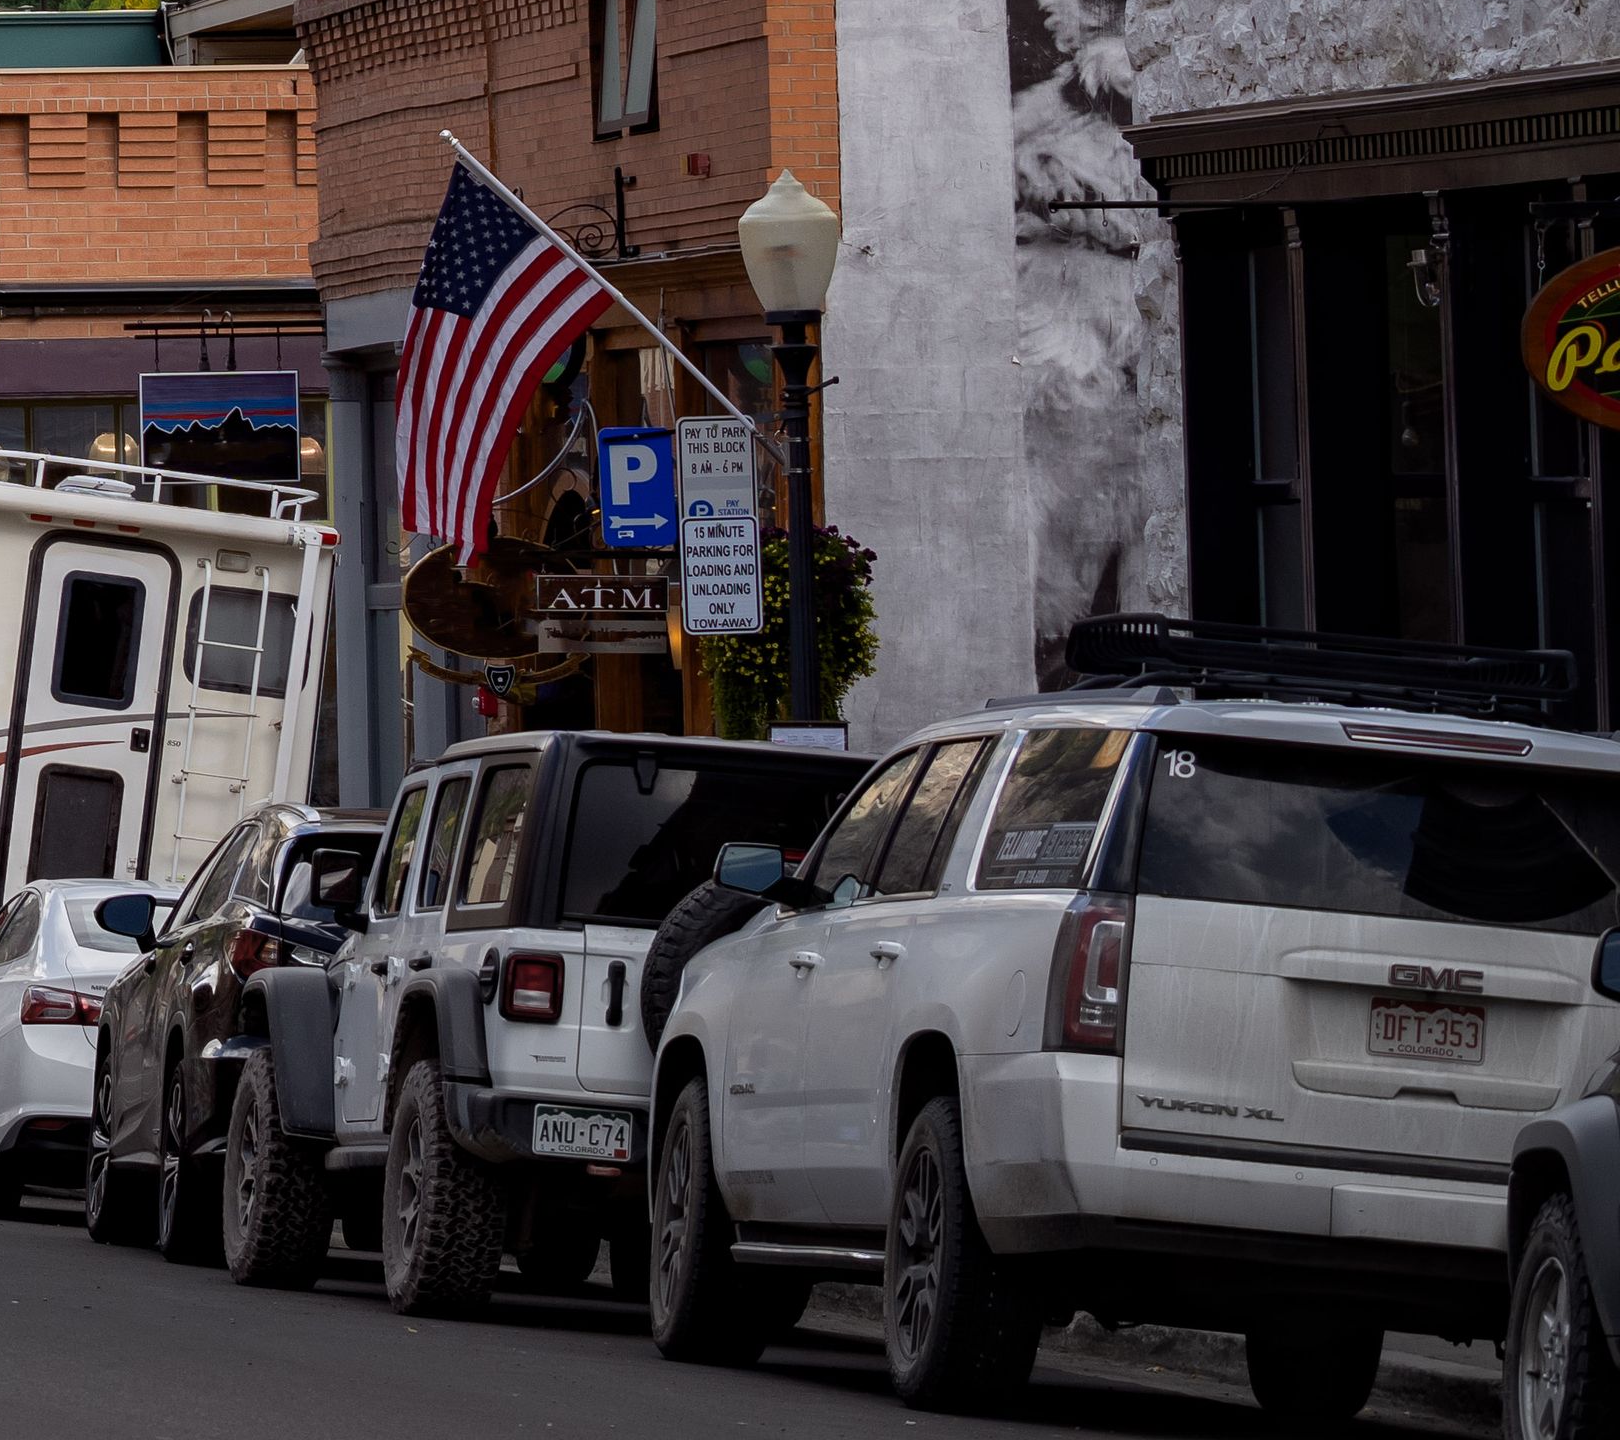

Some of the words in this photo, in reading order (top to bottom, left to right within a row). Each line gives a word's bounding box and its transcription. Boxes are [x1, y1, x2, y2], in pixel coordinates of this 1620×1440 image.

[685, 428, 700, 439] PAY
[705, 427, 718, 439] TO
[721, 426, 747, 438] PARK
[688, 442, 710, 454] THIS
[713, 441, 746, 453] BLOCK
[691, 463, 697, 474] 8
[700, 462, 712, 474] AM
[722, 461, 728, 473] 6
[731, 461, 744, 473] PM
[609, 444, 658, 505] P
[726, 499, 740, 507] PAY
[717, 508, 750, 516] STATION
[694, 526, 705, 539] 15
[707, 525, 745, 538] MINUTE
[686, 545, 731, 558] PARKING
[733, 544, 754, 557] FOR
[687, 564, 732, 577] LOADING
[734, 564, 755, 576] AND
[692, 582, 751, 596] UNLOADING
[708, 602, 736, 615] ONLY
[692, 617, 753, 629] TOW-AWAY
[1163, 749, 1196, 778] 18
[1388, 963, 1484, 994] GMC
[1397, 1044, 1454, 1057] COLORADO
[1136, 1094, 1238, 1117] YUKON
[1242, 1105, 1285, 1122] XL
[558, 1144, 606, 1154] COLORADO
